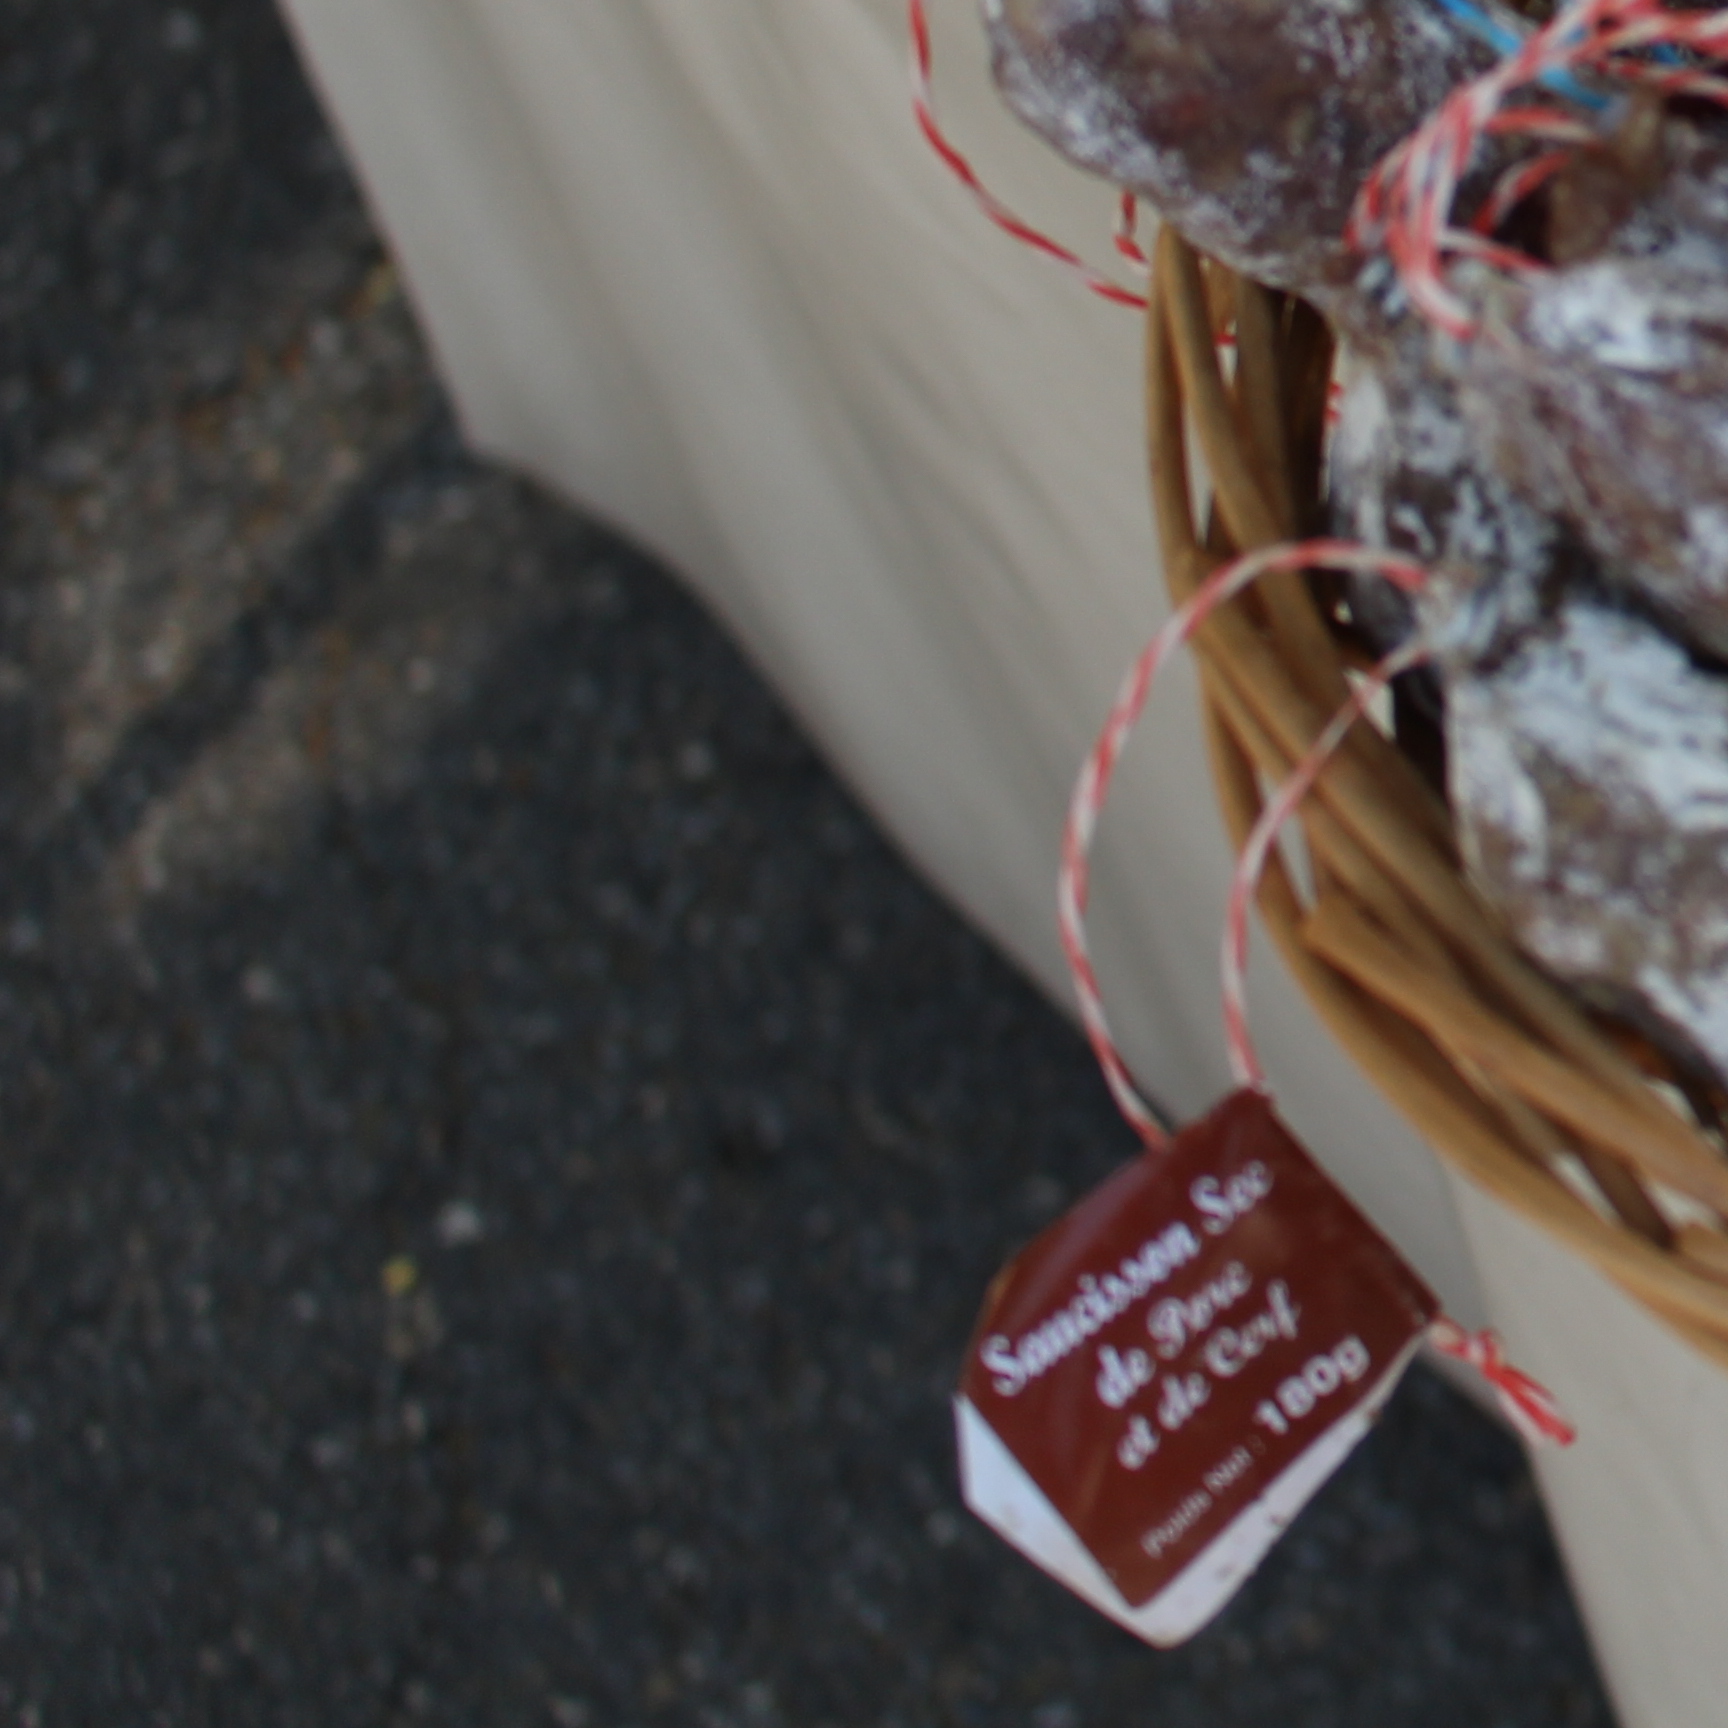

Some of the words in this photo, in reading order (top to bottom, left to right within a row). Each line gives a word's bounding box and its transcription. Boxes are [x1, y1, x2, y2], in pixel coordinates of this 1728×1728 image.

[980, 1221, 1203, 1397] Saucisson
[1190, 1159, 1275, 1235] Sec
[1096, 1344, 1155, 1409] de
[1146, 1260, 1252, 1360] Porc
[1117, 1414, 1160, 1470] et
[1158, 1371, 1212, 1430] de
[1204, 1278, 1301, 1379] Cerf
[1255, 1333, 1371, 1435] 180g
